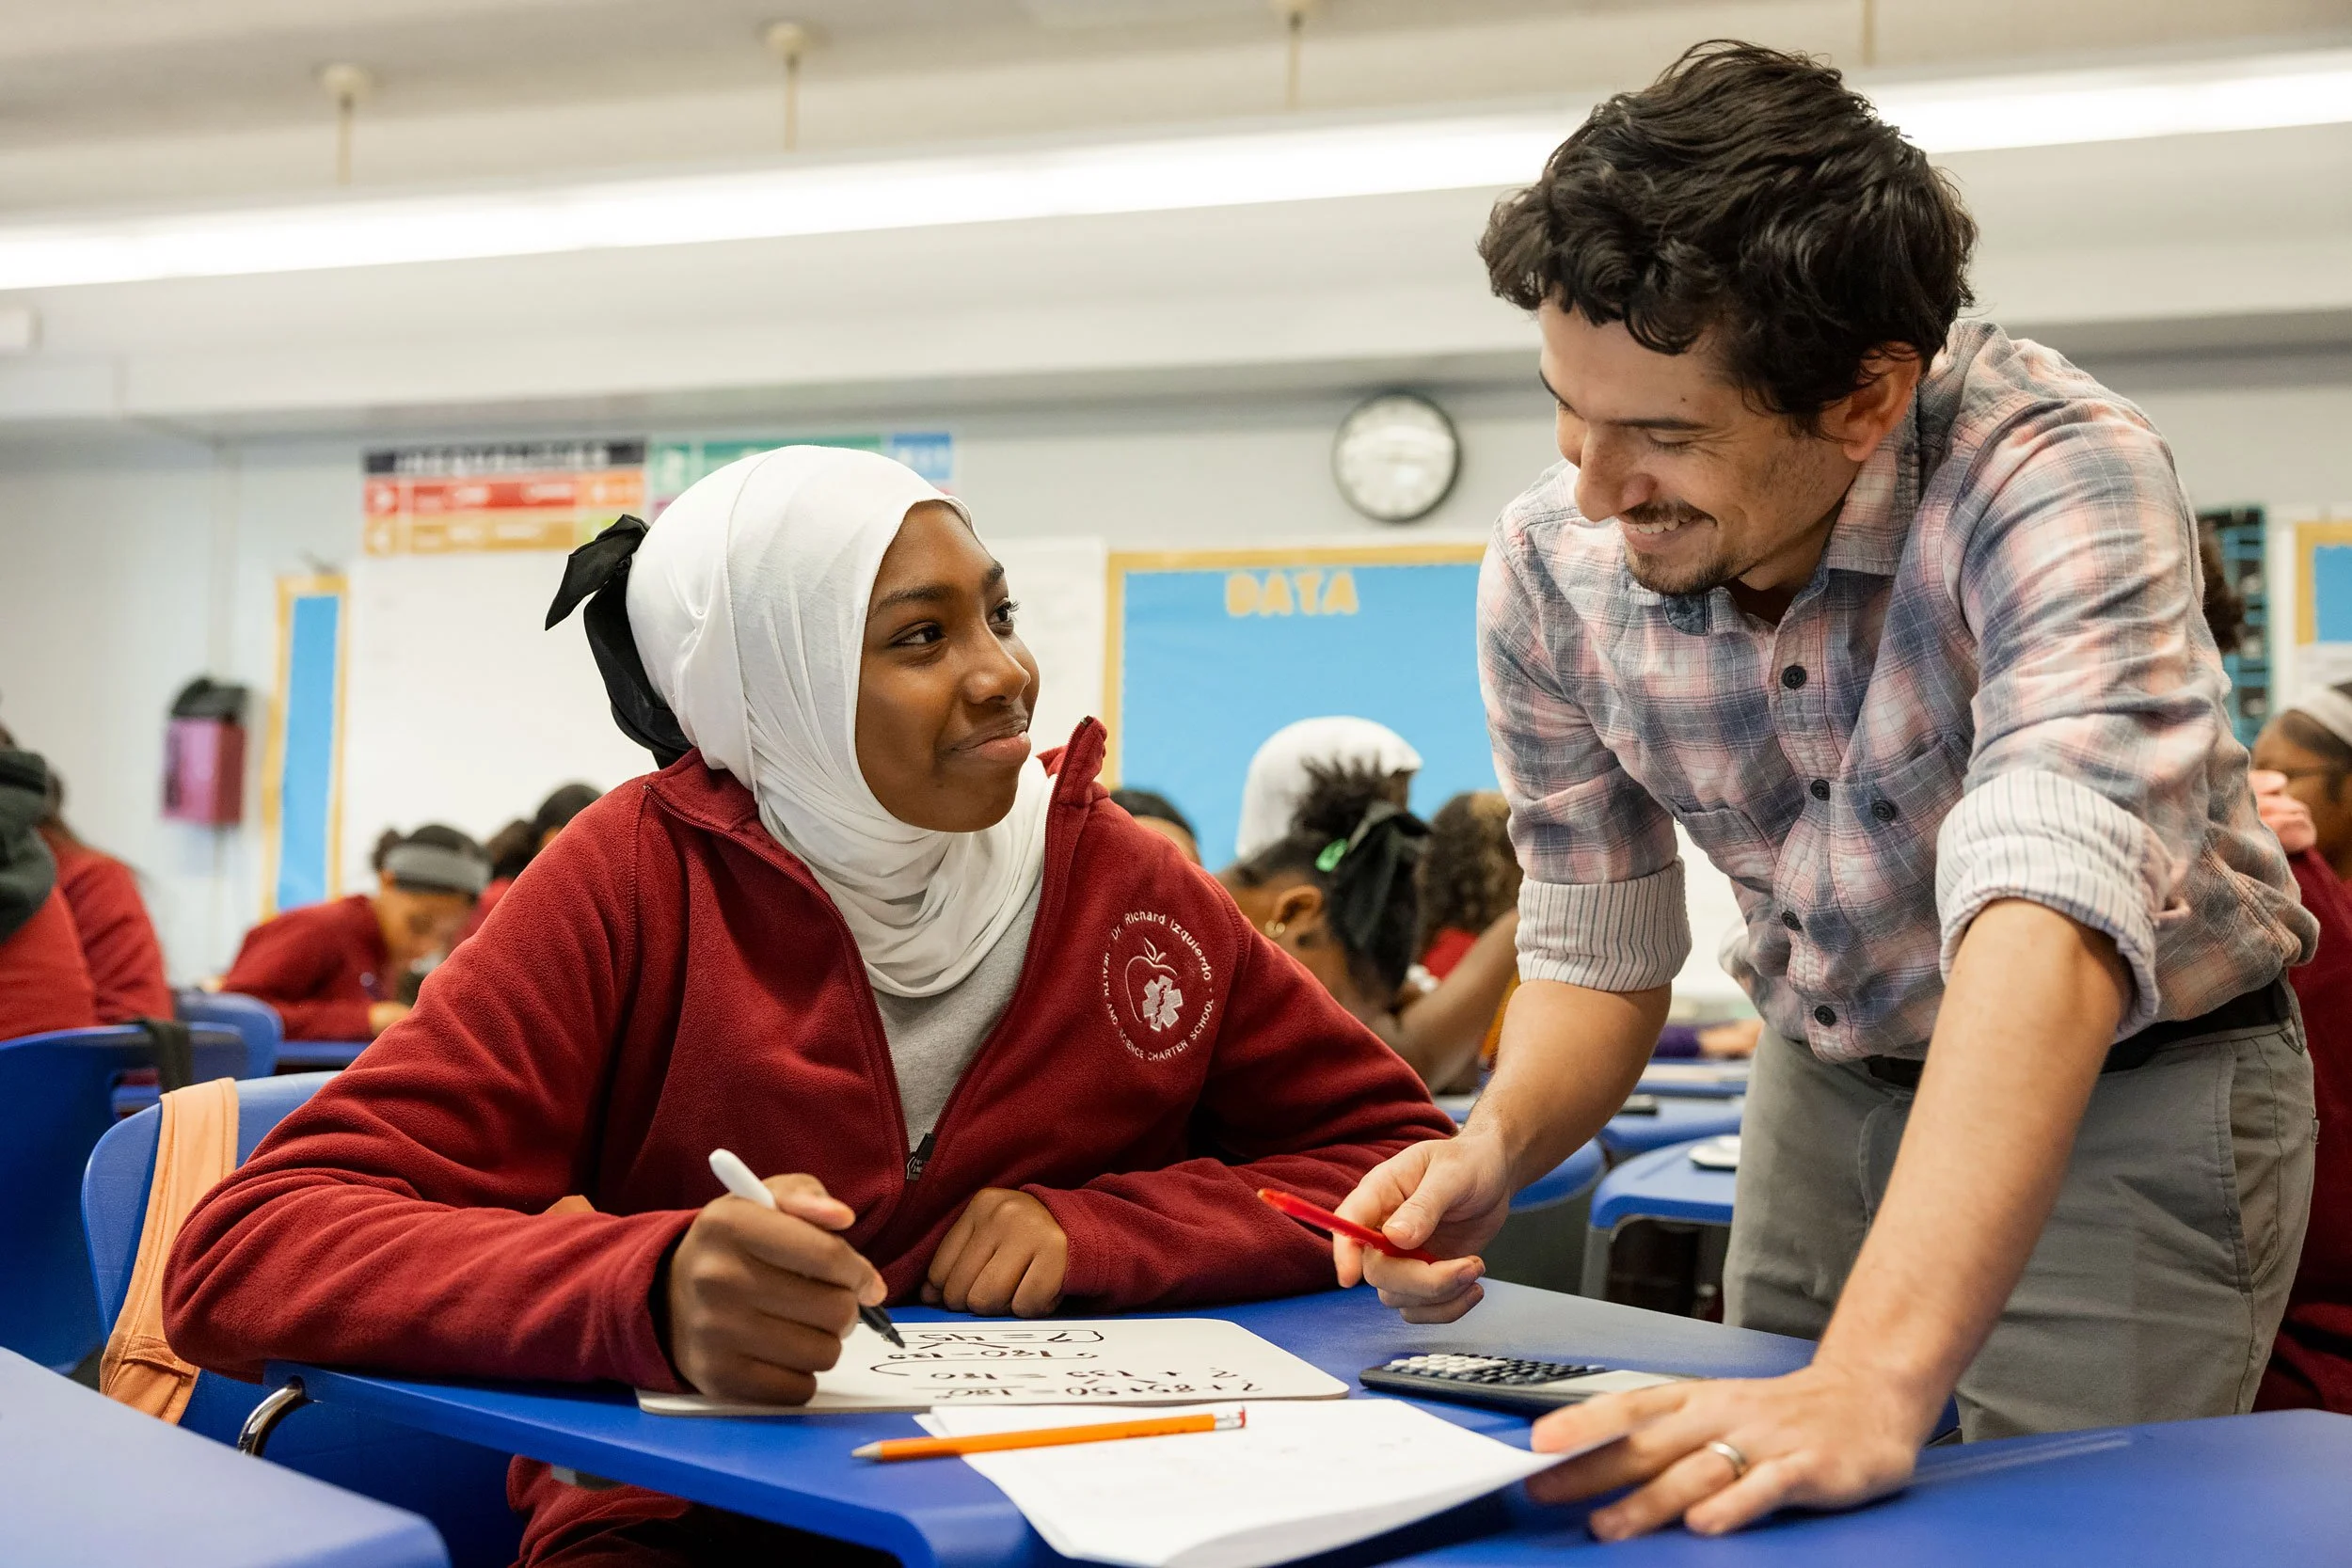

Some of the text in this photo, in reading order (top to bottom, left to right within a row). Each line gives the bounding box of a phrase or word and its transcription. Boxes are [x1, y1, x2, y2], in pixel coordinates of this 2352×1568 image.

[1226, 571, 1359, 617] DATA
[1124, 911, 1166, 926] Richard
[1169, 918, 1212, 981] Izquierdo
[1106, 1002, 1119, 1025] AND
[1148, 1039, 1189, 1061] CHARTER
[1189, 998, 1215, 1040] SCHOOL
[918, 1333, 986, 1341] 45
